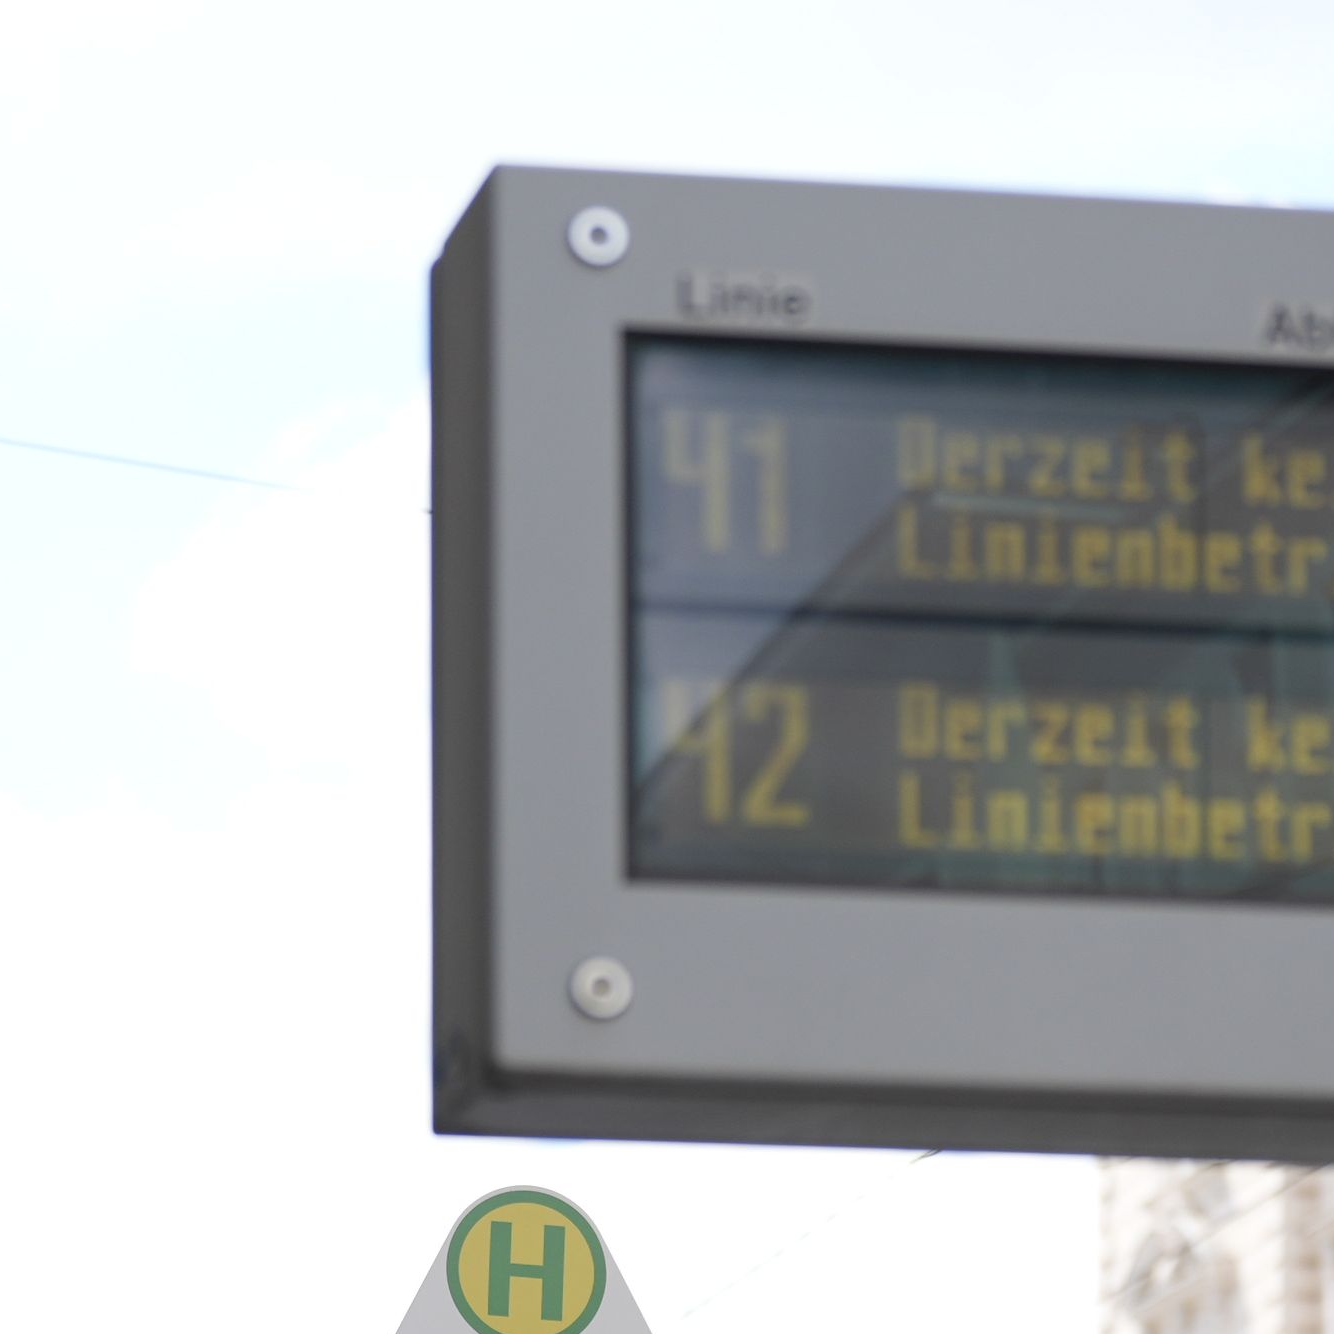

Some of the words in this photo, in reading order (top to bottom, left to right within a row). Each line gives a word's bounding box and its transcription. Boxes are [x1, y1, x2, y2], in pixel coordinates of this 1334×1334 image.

[676, 273, 809, 318] Linie
[665, 410, 787, 556] 41
[898, 414, 1196, 502] Derzeit
[666, 679, 809, 825] 42
[898, 682, 1199, 769] Derzeit
[488, 1220, 565, 1321] H
